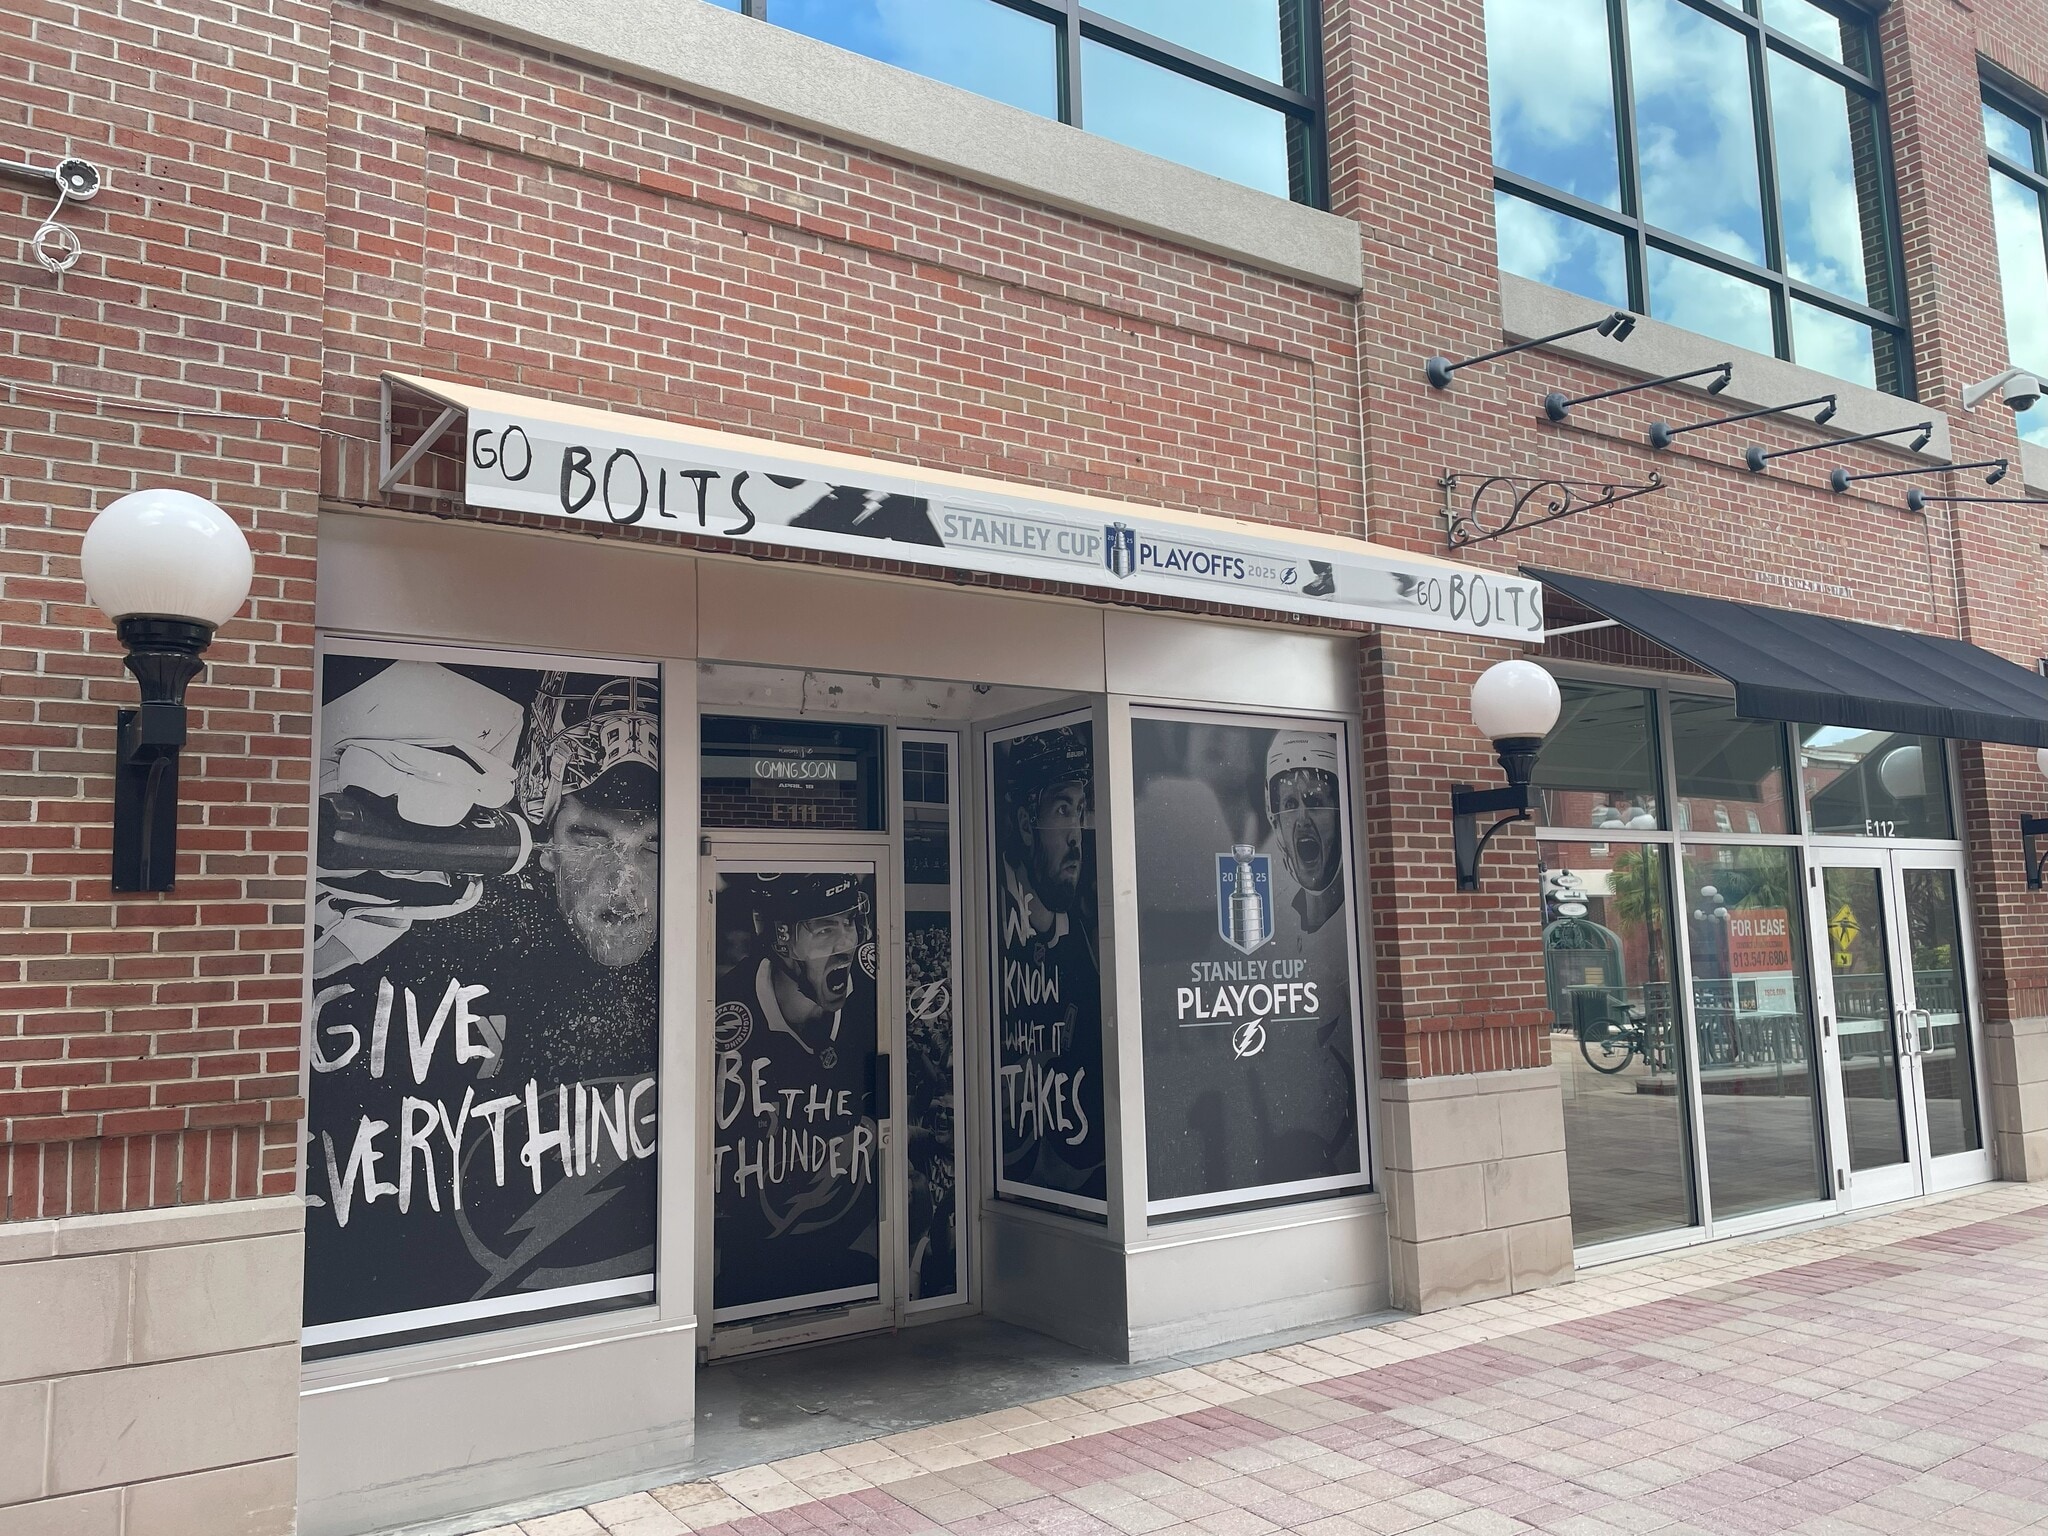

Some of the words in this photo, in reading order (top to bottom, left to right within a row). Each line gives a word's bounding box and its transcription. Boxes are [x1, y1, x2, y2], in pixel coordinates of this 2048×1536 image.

[473, 425, 532, 481] GO
[560, 446, 756, 535] BOLTS
[944, 514, 1051, 551] STANLEY
[1057, 531, 1100, 558] CUP
[1140, 543, 1245, 580] PLAYOFFS
[1248, 565, 1276, 579] 2025
[1417, 578, 1441, 612] GO
[1450, 574, 1543, 631] BOLTS
[755, 761, 798, 778] COMING
[799, 761, 837, 780] SOON
[772, 803, 817, 822] E111
[1865, 819, 1896, 837] E112
[1222, 872, 1233, 882] 20
[1256, 873, 1267, 882] 25
[1001, 881, 1037, 949] WE
[1731, 919, 1752, 937] FOR
[1754, 918, 1786, 936] LEASE
[1003, 956, 1059, 1015] KNOW
[1191, 961, 1268, 983] STANLEY
[1272, 959, 1304, 979] CUP
[729, 1005, 744, 1014] BAY
[1177, 982, 1320, 1020] PLAYOFFS
[310, 976, 495, 1084] GIVE
[1004, 1020, 1045, 1055] WHAT
[1052, 1022, 1065, 1056] IT
[716, 1050, 776, 1130] BE
[778, 1083, 853, 1123] THE
[1000, 1058, 1089, 1146] TAKES
[305, 1077, 656, 1227] VERYTHING
[714, 1125, 873, 1198] THUNDER
